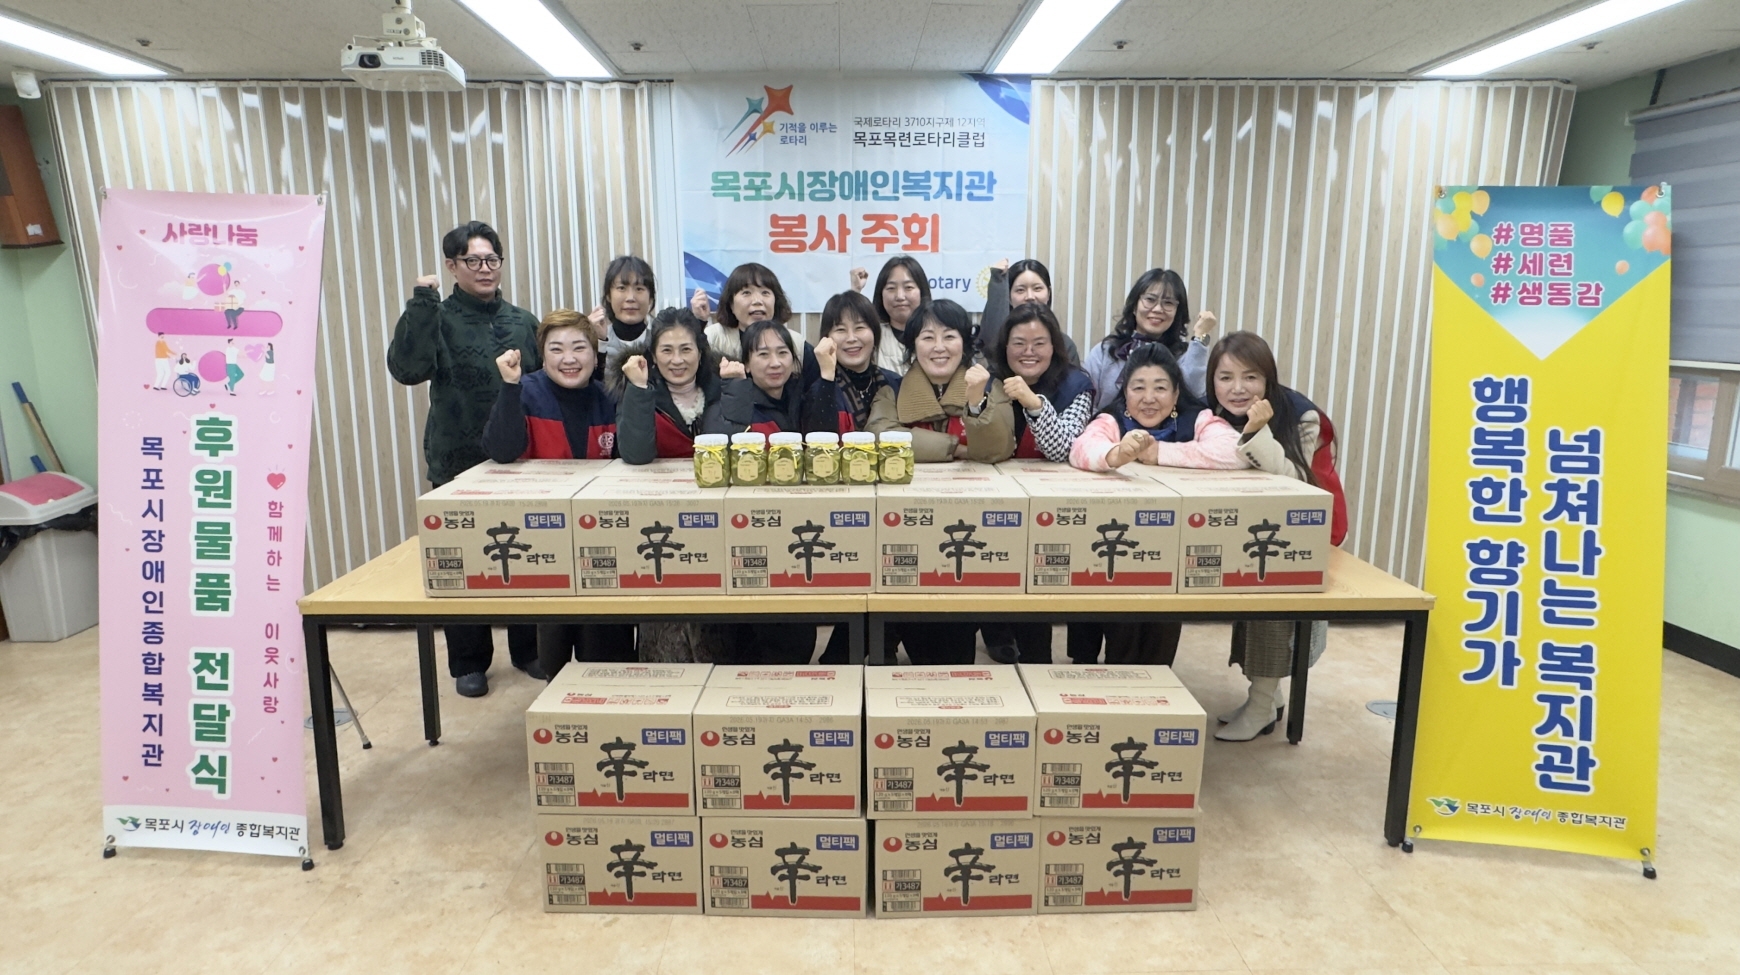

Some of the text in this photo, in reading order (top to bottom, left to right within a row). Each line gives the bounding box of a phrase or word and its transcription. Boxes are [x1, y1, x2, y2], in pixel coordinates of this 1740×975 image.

[779, 123, 838, 133] 기적을 이루는
[854, 116, 901, 128] 국제로타리
[780, 135, 807, 146] 로타리
[853, 132, 985, 147] 목포목련로타리클럽
[710, 170, 997, 202] 목포시장애인복지관
[162, 223, 258, 247] 사랑나눔
[769, 213, 939, 253] 봉사 주회
[1493, 224, 1574, 247] #명품
[1492, 253, 1573, 276] #세련
[928, 275, 971, 293] otary
[1491, 281, 1602, 307] #생동감
[444, 517, 475, 529] 농심
[528, 515, 562, 527] 멀티팩
[599, 517, 629, 528] 농심
[682, 515, 715, 526] 멀티팩
[751, 516, 781, 527] 농심
[834, 513, 866, 525] 멀티팩
[903, 514, 933, 526] 농심
[986, 513, 1018, 525] 멀티팩
[1056, 514, 1086, 525] 농심
[1139, 512, 1171, 524] 멀티팩
[1208, 515, 1238, 527] 농심
[1290, 512, 1322, 523] 멀티팩
[1461, 376, 1530, 687] 행복한 향기가
[483, 521, 556, 583] 辛 라면
[637, 521, 708, 582] 辛 라면
[788, 520, 859, 581] 辛 라면
[939, 519, 1009, 580] 辛 라면
[1091, 518, 1161, 579] 辛 라면
[1243, 519, 1312, 580] 辛 라면
[439, 560, 462, 568] 가3487
[593, 559, 615, 567] 가3487
[141, 436, 165, 768] 목포시장애인종합복지관
[192, 417, 234, 795] 후원물품 전달식
[263, 501, 284, 714] 함께하는 이웃사랑
[1535, 427, 1602, 792] 넘쳐나는 복지관
[555, 731, 588, 743] 농심
[646, 731, 681, 743] 멀티팩
[723, 733, 755, 746] 농심
[814, 732, 850, 744] 멀티팩
[897, 736, 930, 748] 농심
[989, 733, 1025, 746] 멀티팩
[1066, 731, 1099, 743] 농심
[1159, 731, 1194, 743] 멀티팩
[597, 737, 674, 801] 辛 라면
[763, 738, 841, 803] 辛 라면
[937, 740, 1015, 805] 辛 라면
[1105, 737, 1182, 802] 辛 라면
[888, 781, 912, 789] 가3487
[1055, 777, 1079, 785] 가3487
[1467, 803, 1626, 829] 목포시 장애인 종합복지관
[145, 818, 300, 841] 목포시 장애인 종합복지관
[1157, 830, 1191, 841] 멀티팩
[566, 833, 598, 845] 농심
[654, 833, 689, 845] 멀티팩
[731, 836, 763, 848] 농심
[820, 837, 855, 848] 멀티팩
[905, 839, 937, 851] 농심
[994, 835, 1029, 847] 멀티팩
[1068, 833, 1100, 845] 농심
[607, 839, 682, 900] 辛 라면
[771, 842, 847, 904] 辛 라면
[944, 843, 1019, 904] 辛 라면
[1106, 837, 1181, 899] 辛 라면
[896, 882, 919, 890] 가3487
